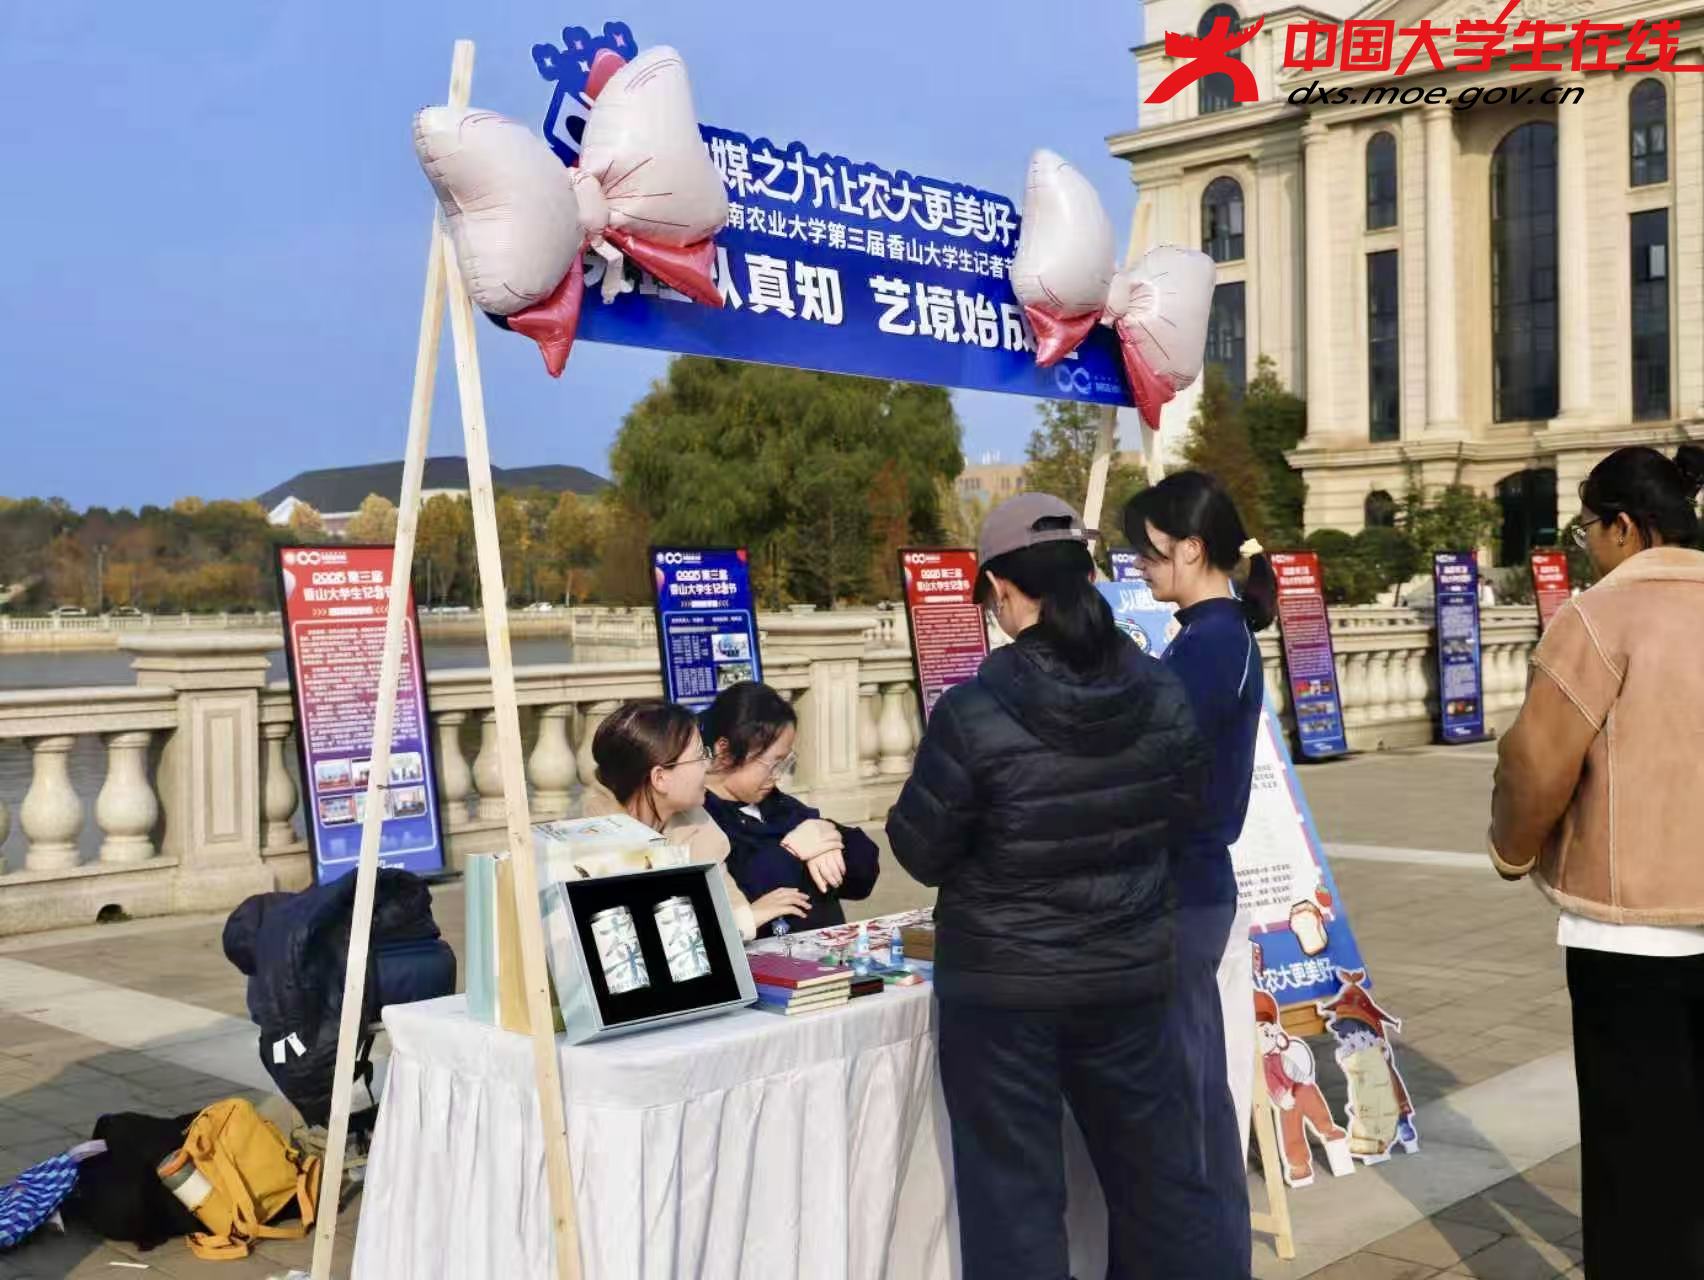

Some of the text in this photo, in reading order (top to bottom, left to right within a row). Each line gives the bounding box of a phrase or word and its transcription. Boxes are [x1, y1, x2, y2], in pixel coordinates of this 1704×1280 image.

[704, 136, 1017, 248] 媒之力让农大更美好
[869, 275, 1079, 360] 艺境始成
